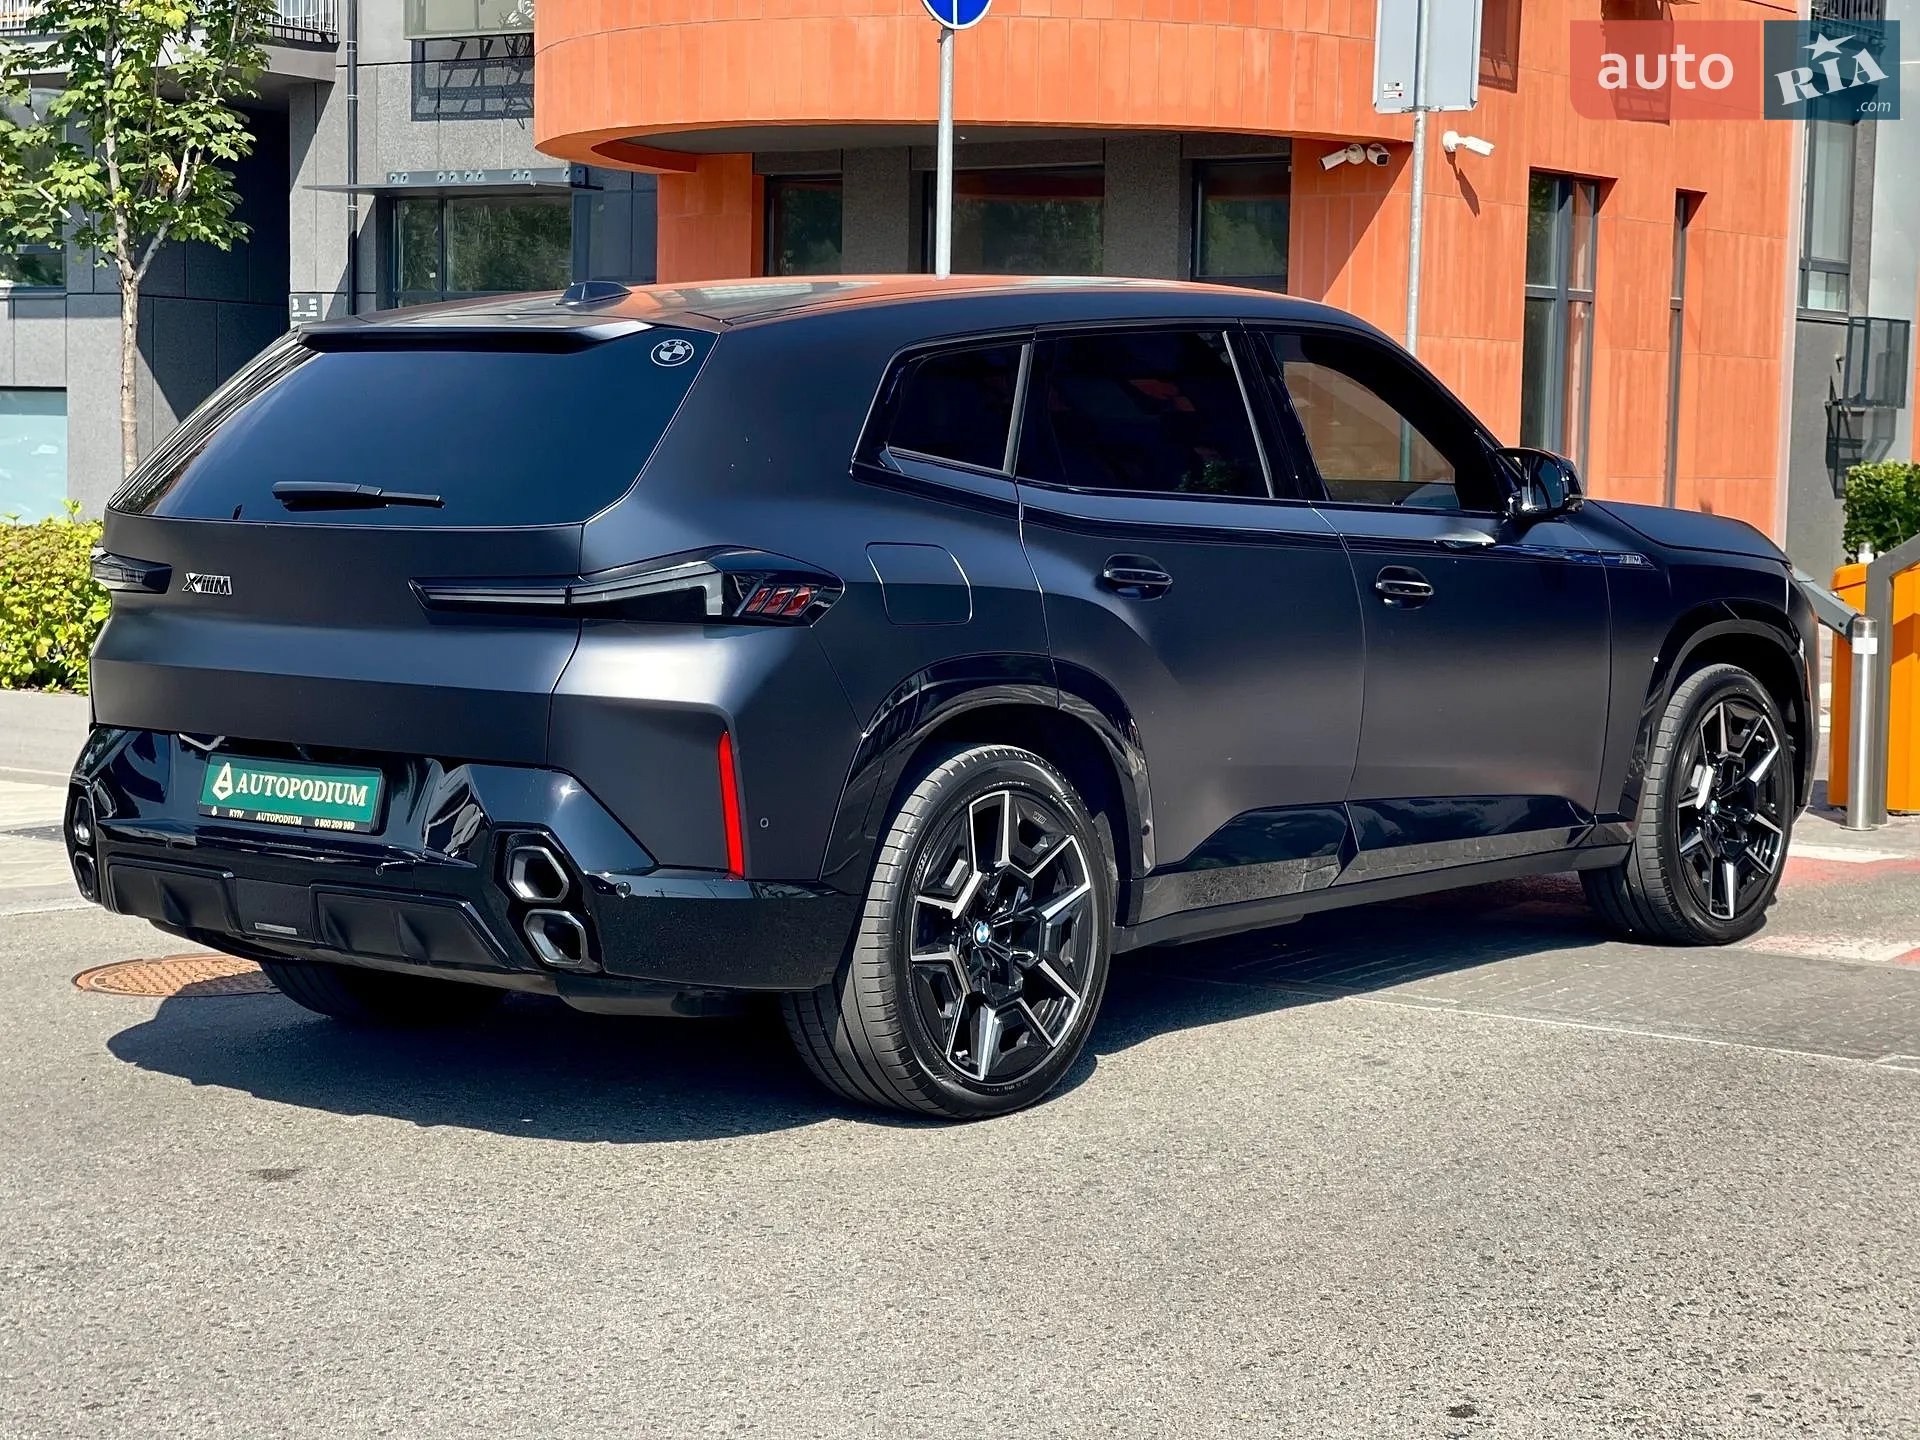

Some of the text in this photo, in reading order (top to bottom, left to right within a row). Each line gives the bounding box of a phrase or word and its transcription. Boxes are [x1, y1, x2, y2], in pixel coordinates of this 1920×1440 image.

[236, 774, 368, 806] AUTOPODIUM
[229, 809, 244, 818] KYIV
[256, 812, 303, 825] AUTOPODIUM
